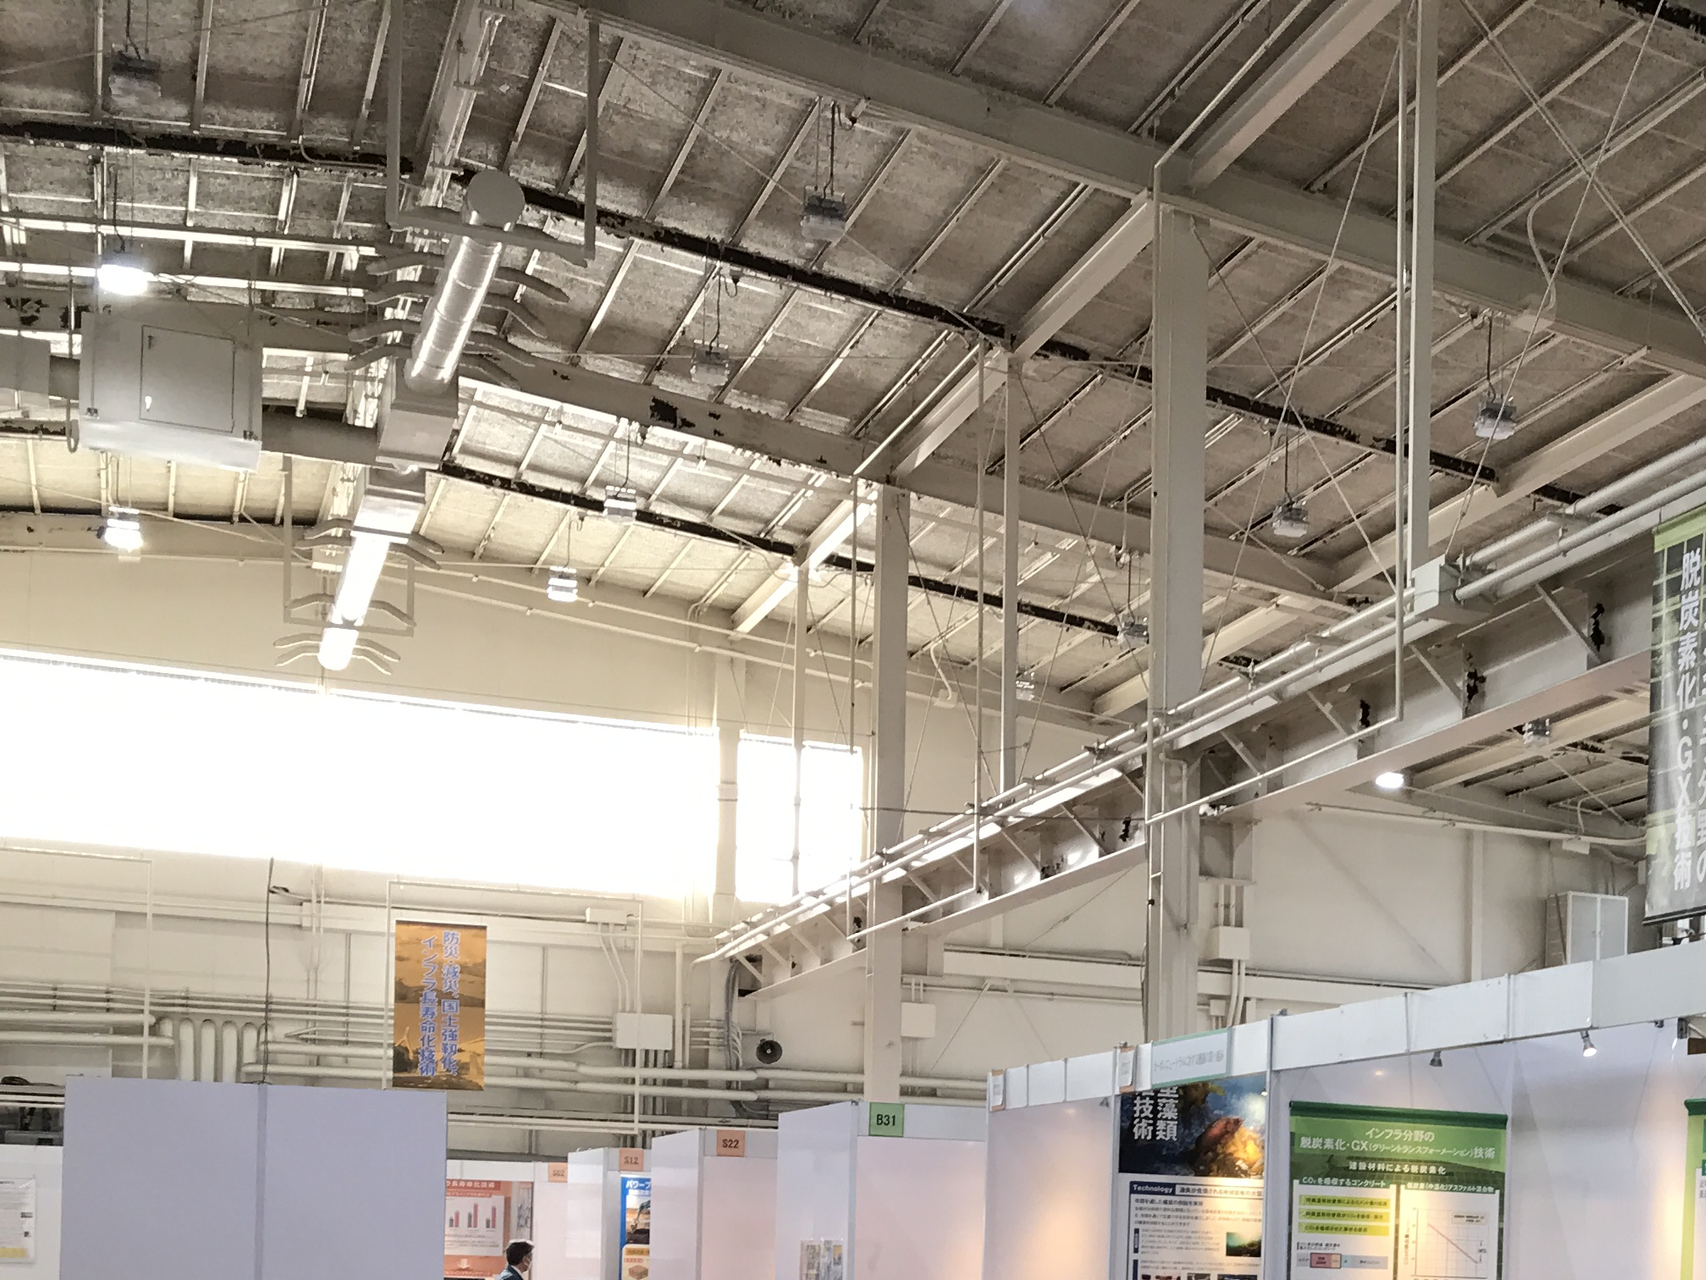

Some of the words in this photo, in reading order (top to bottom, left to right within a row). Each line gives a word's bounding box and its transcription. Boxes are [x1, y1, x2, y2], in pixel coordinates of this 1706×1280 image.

[418, 936, 438, 1077] インフラ長寿命化技術
[876, 1114, 896, 1127] B31
[1133, 1092, 1154, 1140] 技術
[1365, 1127, 1435, 1143] インフラ分野の
[722, 1139, 739, 1149] S22
[623, 1156, 639, 1165] S12
[1349, 1161, 1447, 1175] 建設材料による脱炭素化
[1133, 1183, 1174, 1194] Technology
